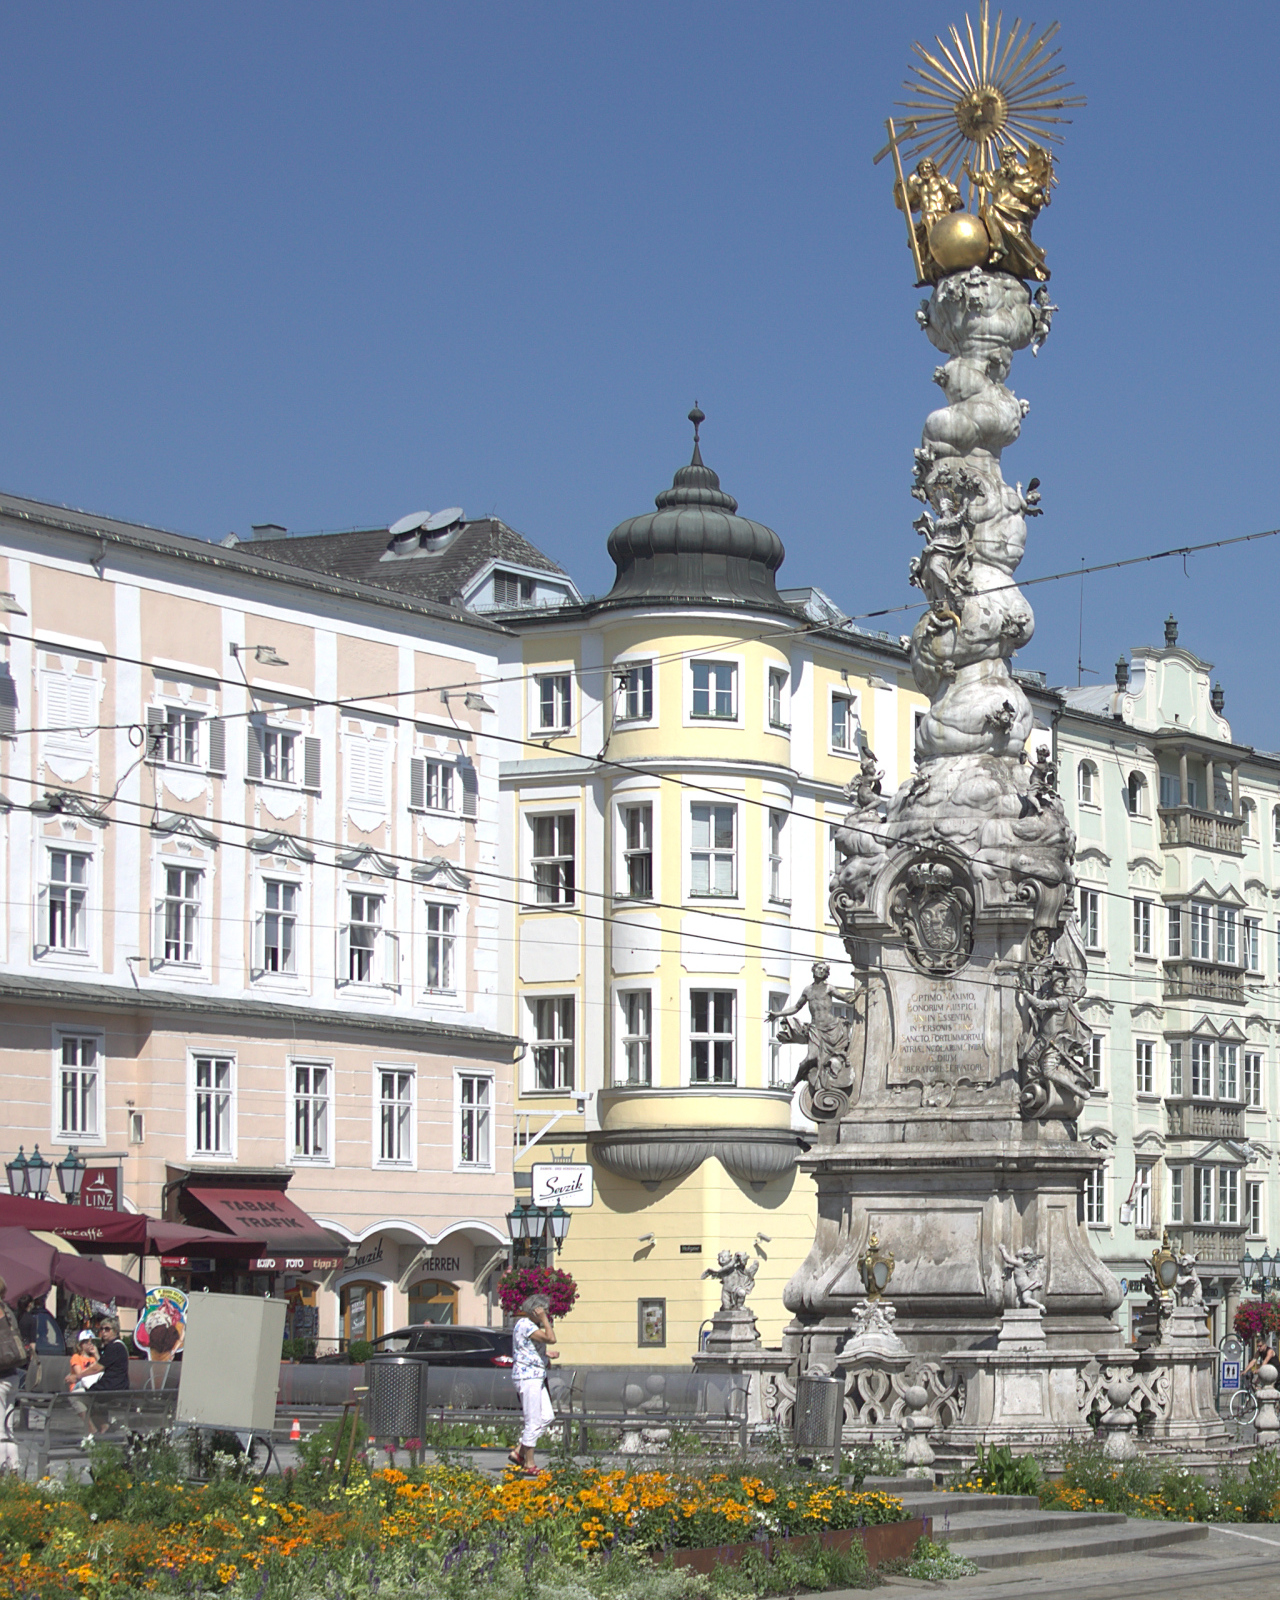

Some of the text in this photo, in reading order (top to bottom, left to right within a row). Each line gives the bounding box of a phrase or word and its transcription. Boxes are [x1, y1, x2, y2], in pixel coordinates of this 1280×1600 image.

[86, 1194, 114, 1207] LINZ
[220, 1200, 285, 1212] TABAK
[235, 1217, 305, 1228] TRAFIK
[285, 1258, 305, 1268] TOTO
[422, 1257, 460, 1271] HERREN
